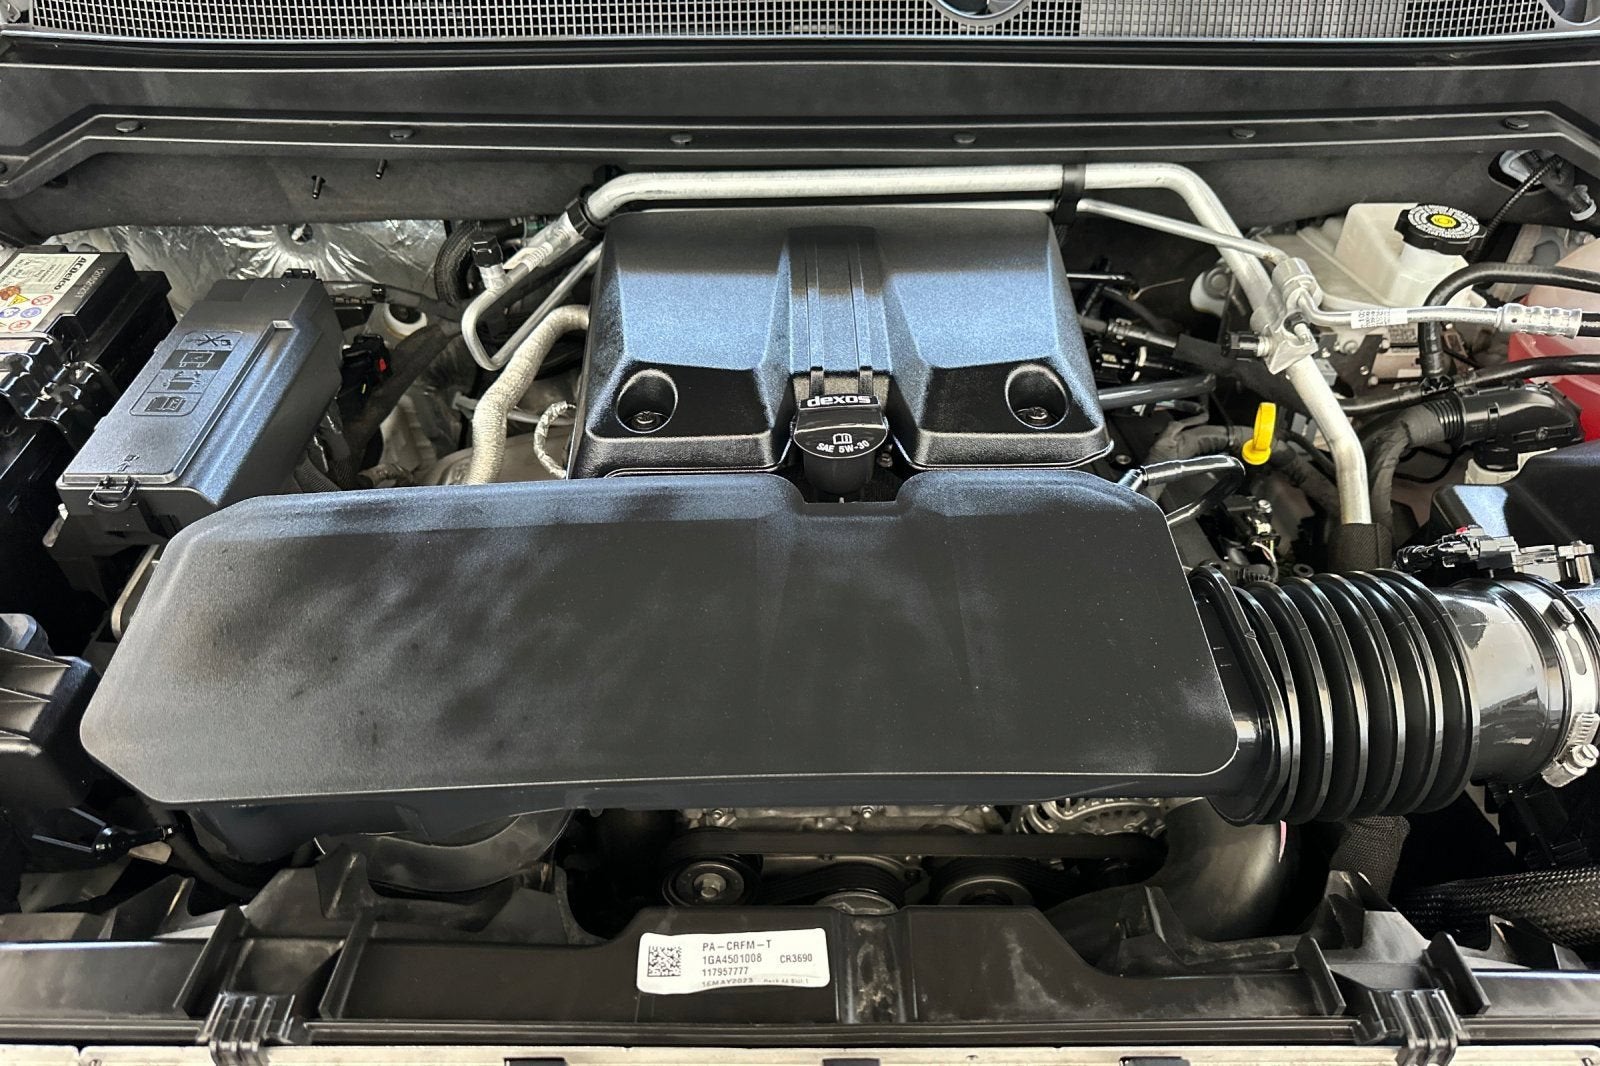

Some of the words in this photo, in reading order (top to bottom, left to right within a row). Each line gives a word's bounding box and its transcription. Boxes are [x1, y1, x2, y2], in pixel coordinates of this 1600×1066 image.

[54, 257, 87, 290] ACDelco
[807, 395, 871, 407] dexos
[816, 442, 835, 453] SAE
[838, 440, 870, 454] 5W-30
[702, 953, 762, 965] 1GA4501008
[779, 953, 813, 963] CR3690
[702, 966, 749, 976] 117957777
